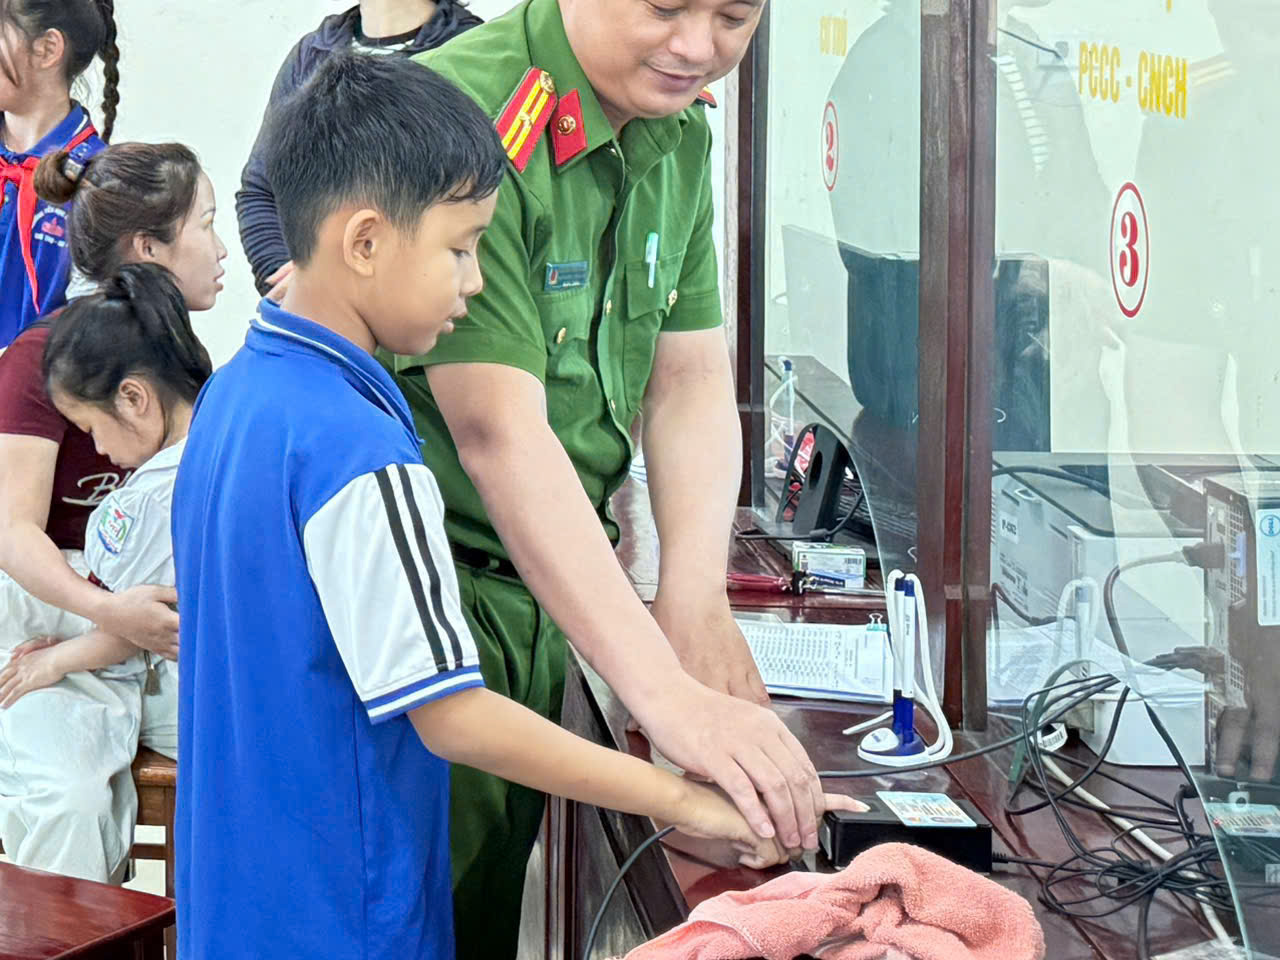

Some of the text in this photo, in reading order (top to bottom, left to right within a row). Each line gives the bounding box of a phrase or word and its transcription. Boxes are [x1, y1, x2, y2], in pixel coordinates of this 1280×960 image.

[1078, 41, 1120, 104] PCCC
[1138, 49, 1188, 121] CNCH
[825, 120, 835, 173] 2
[1119, 211, 1140, 288] 3
